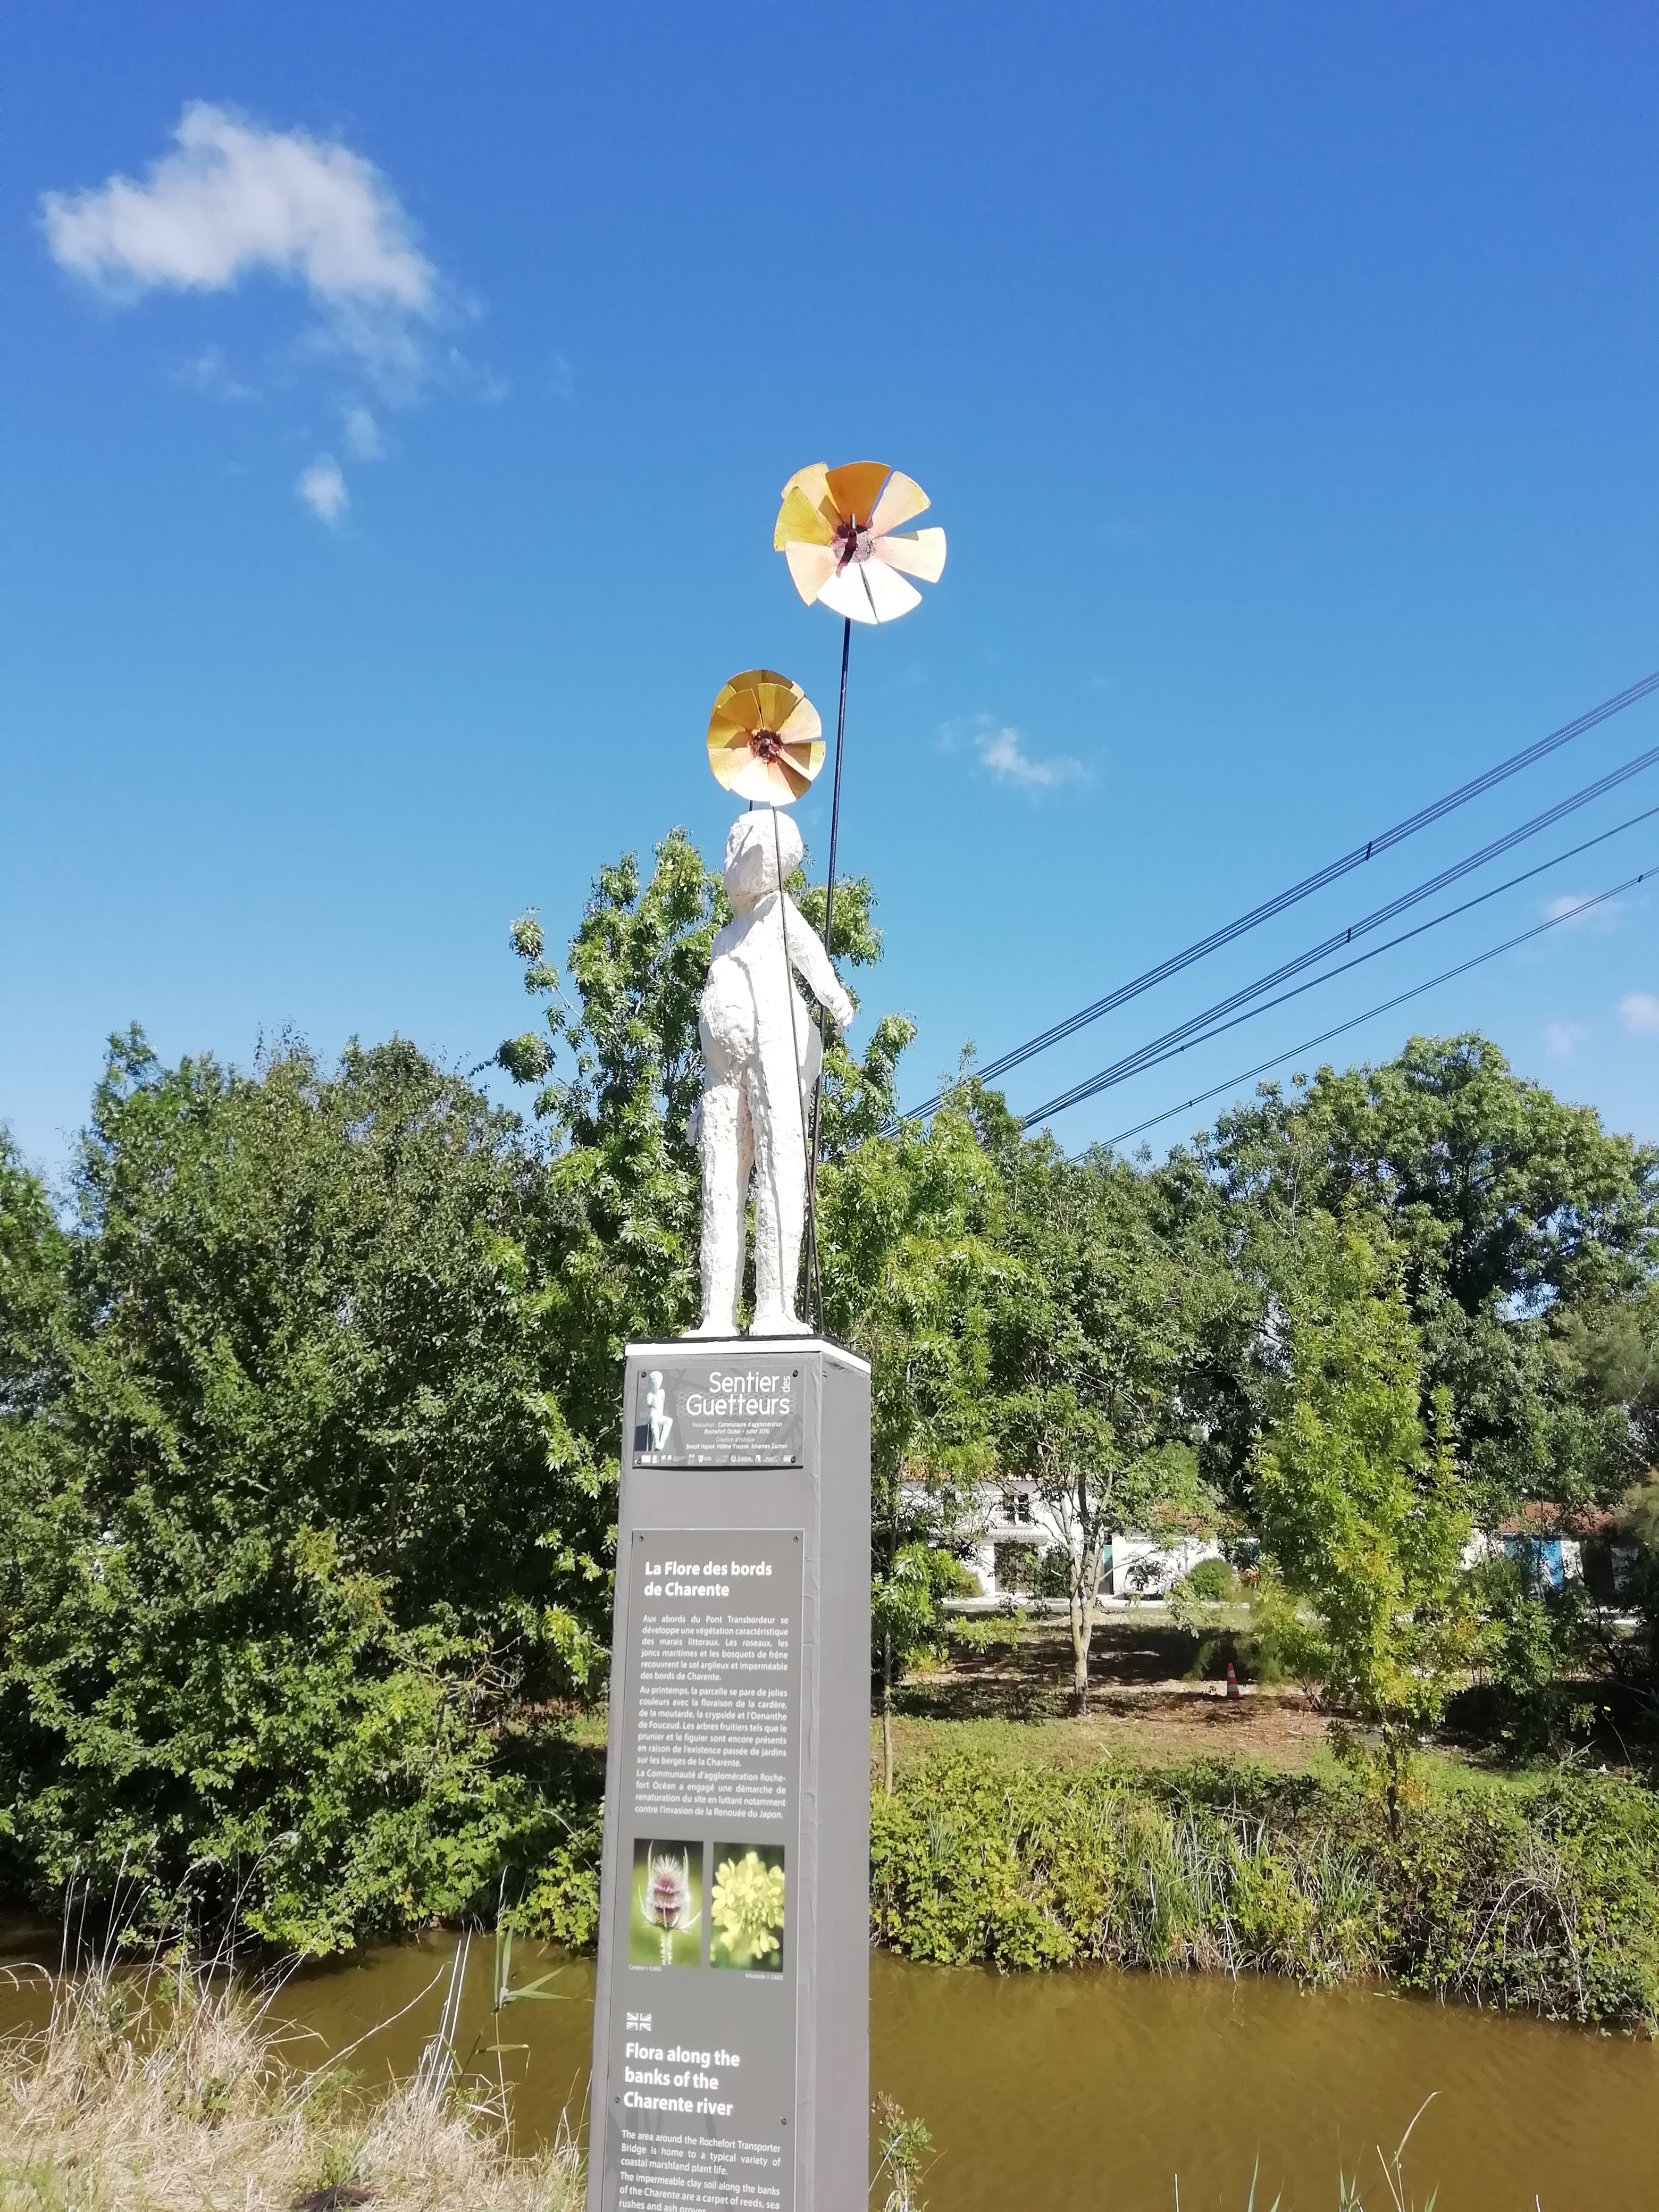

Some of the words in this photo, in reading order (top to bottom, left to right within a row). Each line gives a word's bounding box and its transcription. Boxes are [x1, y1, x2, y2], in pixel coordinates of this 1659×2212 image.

[709, 1371, 779, 1393] Sentier
[781, 1376, 790, 1393] des
[686, 1394, 790, 1415] Guetteurs
[645, 1562, 661, 1576] La
[665, 1561, 700, 1575] Flore
[702, 1561, 728, 1575] des
[731, 1562, 772, 1576] bords
[644, 1582, 663, 1596] de
[665, 1582, 730, 1596] Charente
[727, 1615, 775, 1624] Transbordeur
[642, 1626, 680, 1636] développe
[695, 1627, 734, 1637] végétation
[735, 1628, 789, 1637] caractéristique
[640, 1649, 660, 1658] joncs
[662, 1649, 698, 1657] maritimes
[722, 1649, 755, 1659] bosquets
[700, 1661, 730, 1671] argileux
[740, 1662, 788, 1671] imperméable
[686, 1672, 722, 1680] Charente.
[651, 1687, 690, 1696] printemps,
[699, 1687, 728, 1696] parcelle
[767, 1688, 787, 1698] jolies
[658, 1710, 695, 1719] moutarde,
[697, 1710, 703, 1719] la
[747, 1711, 787, 1721] l'Oenanthe
[638, 1733, 665, 1741] prunier
[684, 1733, 708, 1744] figuier
[755, 1736, 787, 1745] présents
[649, 1756, 660, 1764] les
[661, 1756, 686, 1766] berges
[687, 1757, 697, 1765] de
[706, 1757, 742, 1767] Charente.
[646, 1769, 696, 1779] Communauté
[697, 1771, 758, 1781] d'agglomération
[760, 1773, 786, 1782] Roche-
[635, 1780, 649, 1789] fort
[652, 1781, 676, 1790] Océan
[686, 1783, 715, 1793] engagé
[735, 1784, 773, 1794] démarche
[776, 1786, 786, 1794] de
[659, 1805, 693, 1814] l'invasion
[694, 1807, 705, 1815] de
[714, 1807, 747, 1817] Renouée
[747, 1809, 758, 1817] du
[759, 1810, 783, 1819] Japon.
[625, 2043, 664, 2060] Flora
[666, 2046, 711, 2068] along
[714, 2049, 740, 2067] the
[624, 2066, 671, 2085] banks
[673, 2071, 691, 2087] of
[692, 2072, 719, 2090] the
[623, 2092, 694, 2113] Charente
[697, 2098, 733, 2116] river
[622, 2130, 636, 2139] The
[655, 2134, 682, 2143] around
[684, 2135, 697, 2144] the
[699, 2136, 736, 2148] Rochefort
[737, 2140, 781, 2152] Transporter
[621, 2143, 647, 2155] Bridge
[650, 2146, 657, 2155] is
[661, 2147, 684, 2157] home
[688, 2150, 697, 2158] to
[710, 2152, 736, 2163] typical
[740, 2156, 768, 2167] variety
[772, 2158, 781, 2166] of
[621, 2158, 648, 2167] coastal
[649, 2160, 690, 2171] marshland
[691, 2164, 712, 2173] plant
[714, 2165, 728, 2175] life.
[620, 2172, 634, 2181] The
[636, 2173, 685, 2186] impermeable
[686, 2178, 702, 2189] clay
[703, 2181, 717, 2189] soil
[718, 2182, 741, 2194] along
[742, 2183, 756, 2193] the
[757, 2184, 780, 2196] banks
[619, 2185, 629, 2193] of
[629, 2186, 643, 2195] the
[644, 2188, 681, 2199] Charente
[702, 2195, 728, 2205] carpet
[730, 2197, 739, 2205] of
[740, 2198, 765, 2209] reeds,
[619, 2199, 645, 2209] rushes
[646, 2202, 662, 2211] and
[663, 2203, 677, 2212] ash
